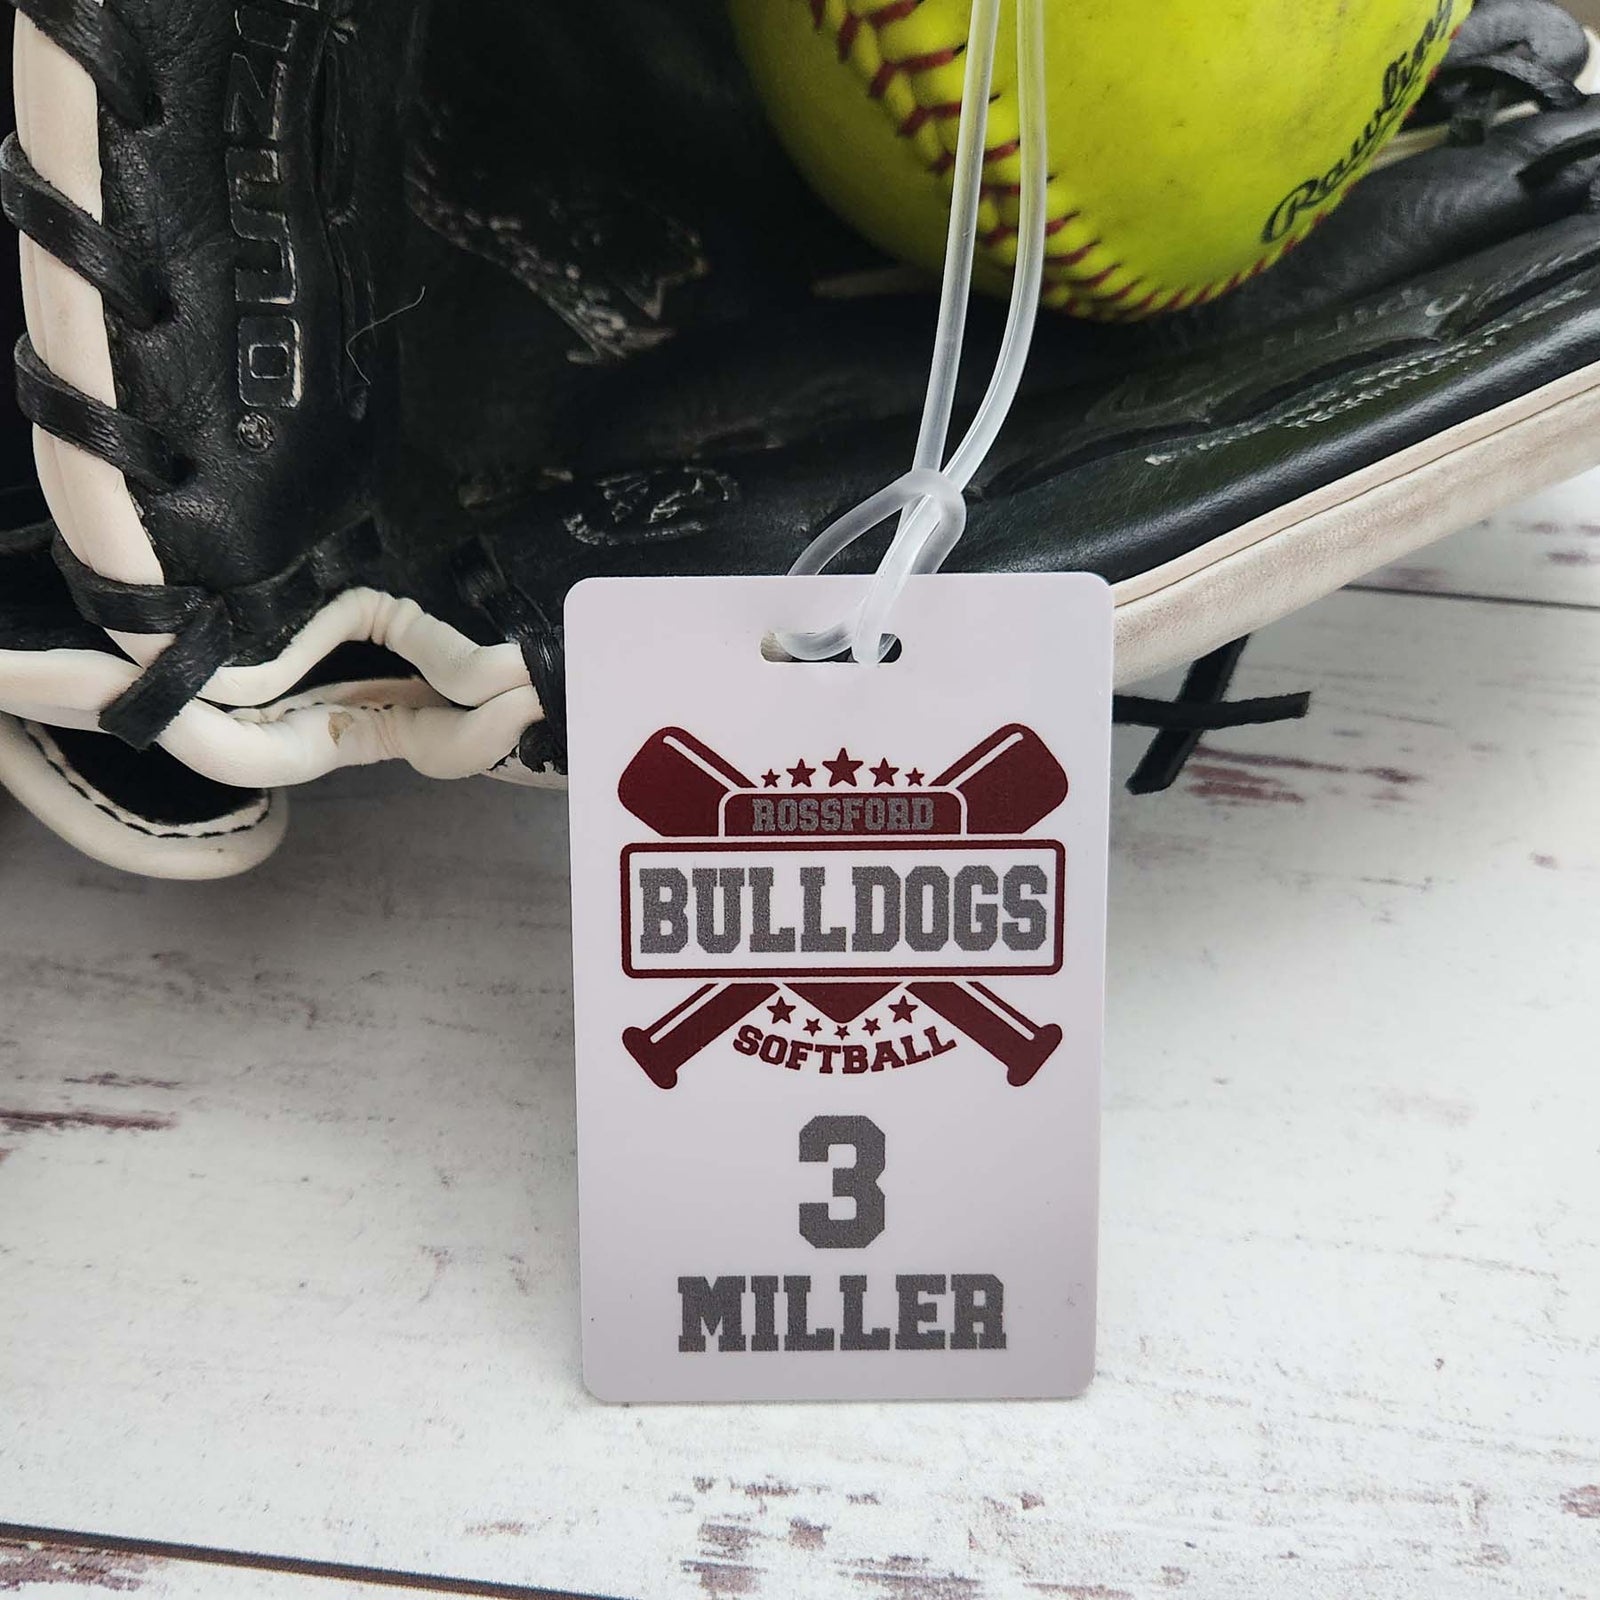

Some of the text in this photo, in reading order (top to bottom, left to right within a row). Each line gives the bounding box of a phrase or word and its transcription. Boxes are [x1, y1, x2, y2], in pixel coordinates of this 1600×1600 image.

[224, 0, 306, 407] IZUNO
[752, 797, 934, 833] ROSSFORD
[639, 864, 1049, 954] BULLDOGS
[732, 1023, 957, 1075] SOFTBALL
[798, 1114, 887, 1249] 3
[677, 1273, 1008, 1353] MILLER
